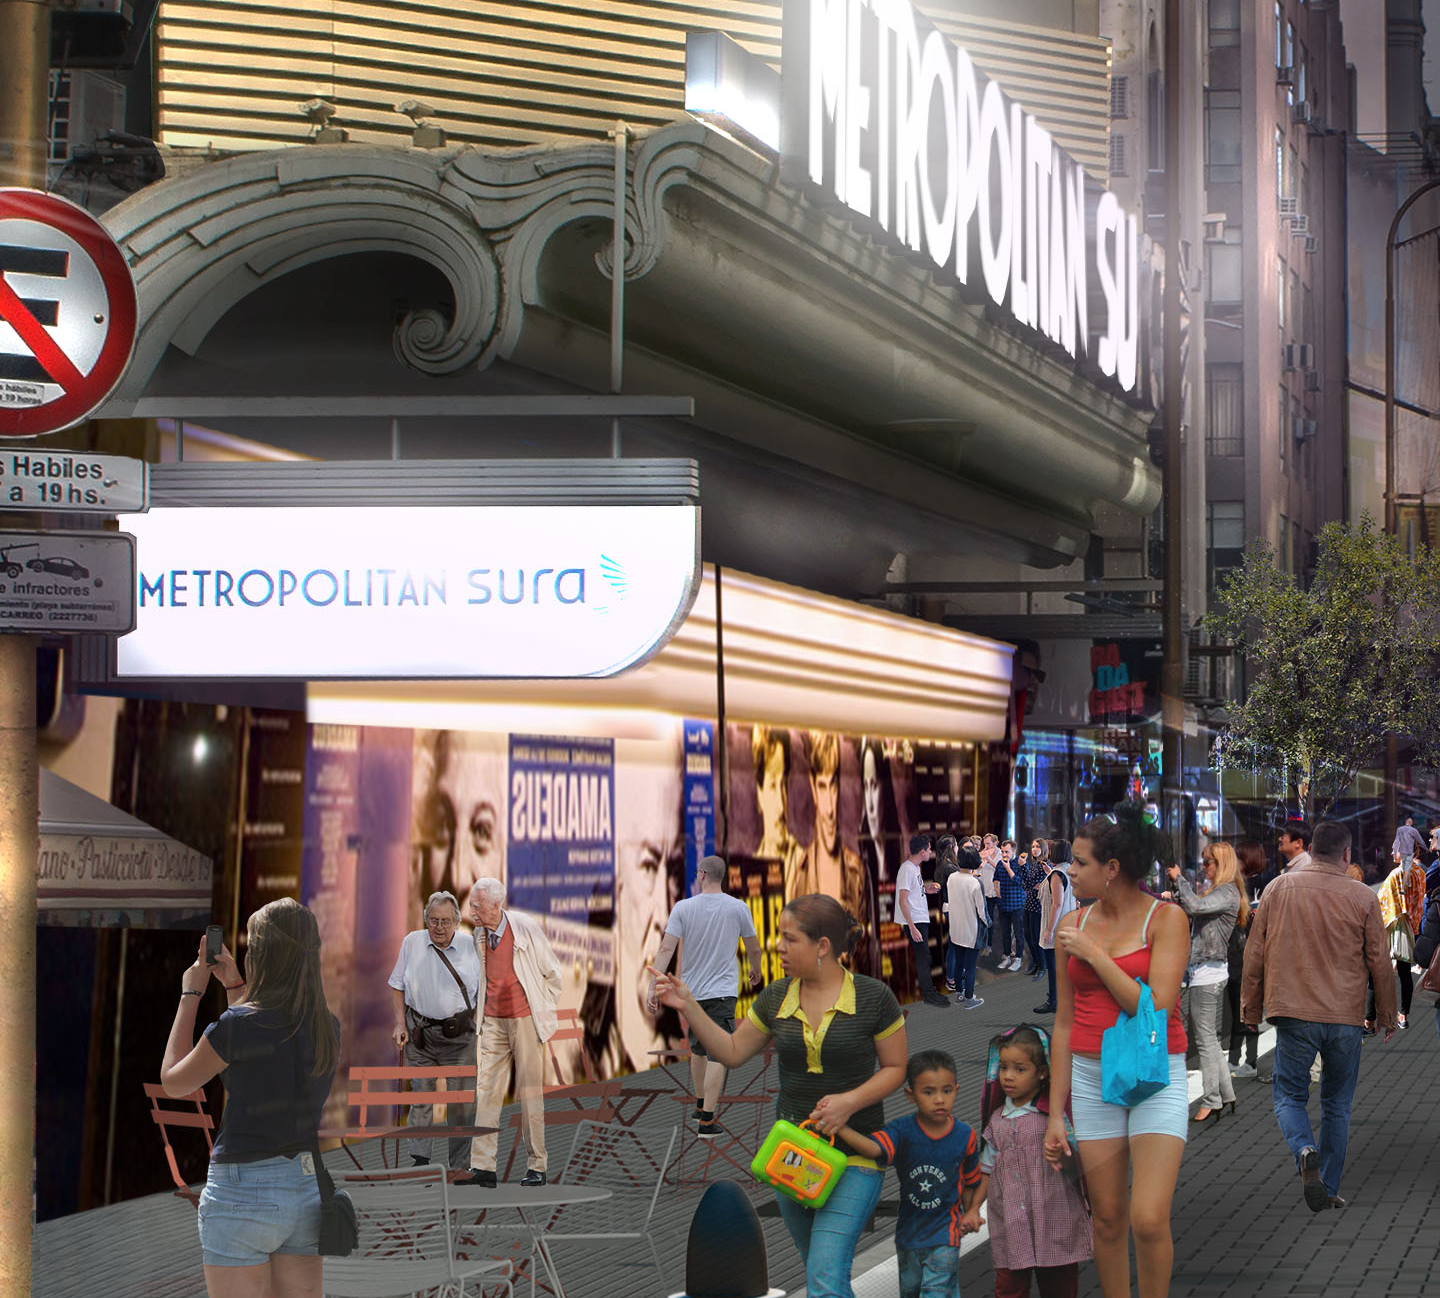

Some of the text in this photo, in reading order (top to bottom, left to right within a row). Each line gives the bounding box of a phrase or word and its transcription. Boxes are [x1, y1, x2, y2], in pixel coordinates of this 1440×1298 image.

[13, 456, 104, 481] Habiles
[8, 485, 24, 503] a
[13, 580, 91, 598] infractores
[140, 567, 586, 608] METROPOLITAN sura
[908, 1164, 949, 1185] CONVERSE
[908, 1192, 943, 1211] ALL STAR
